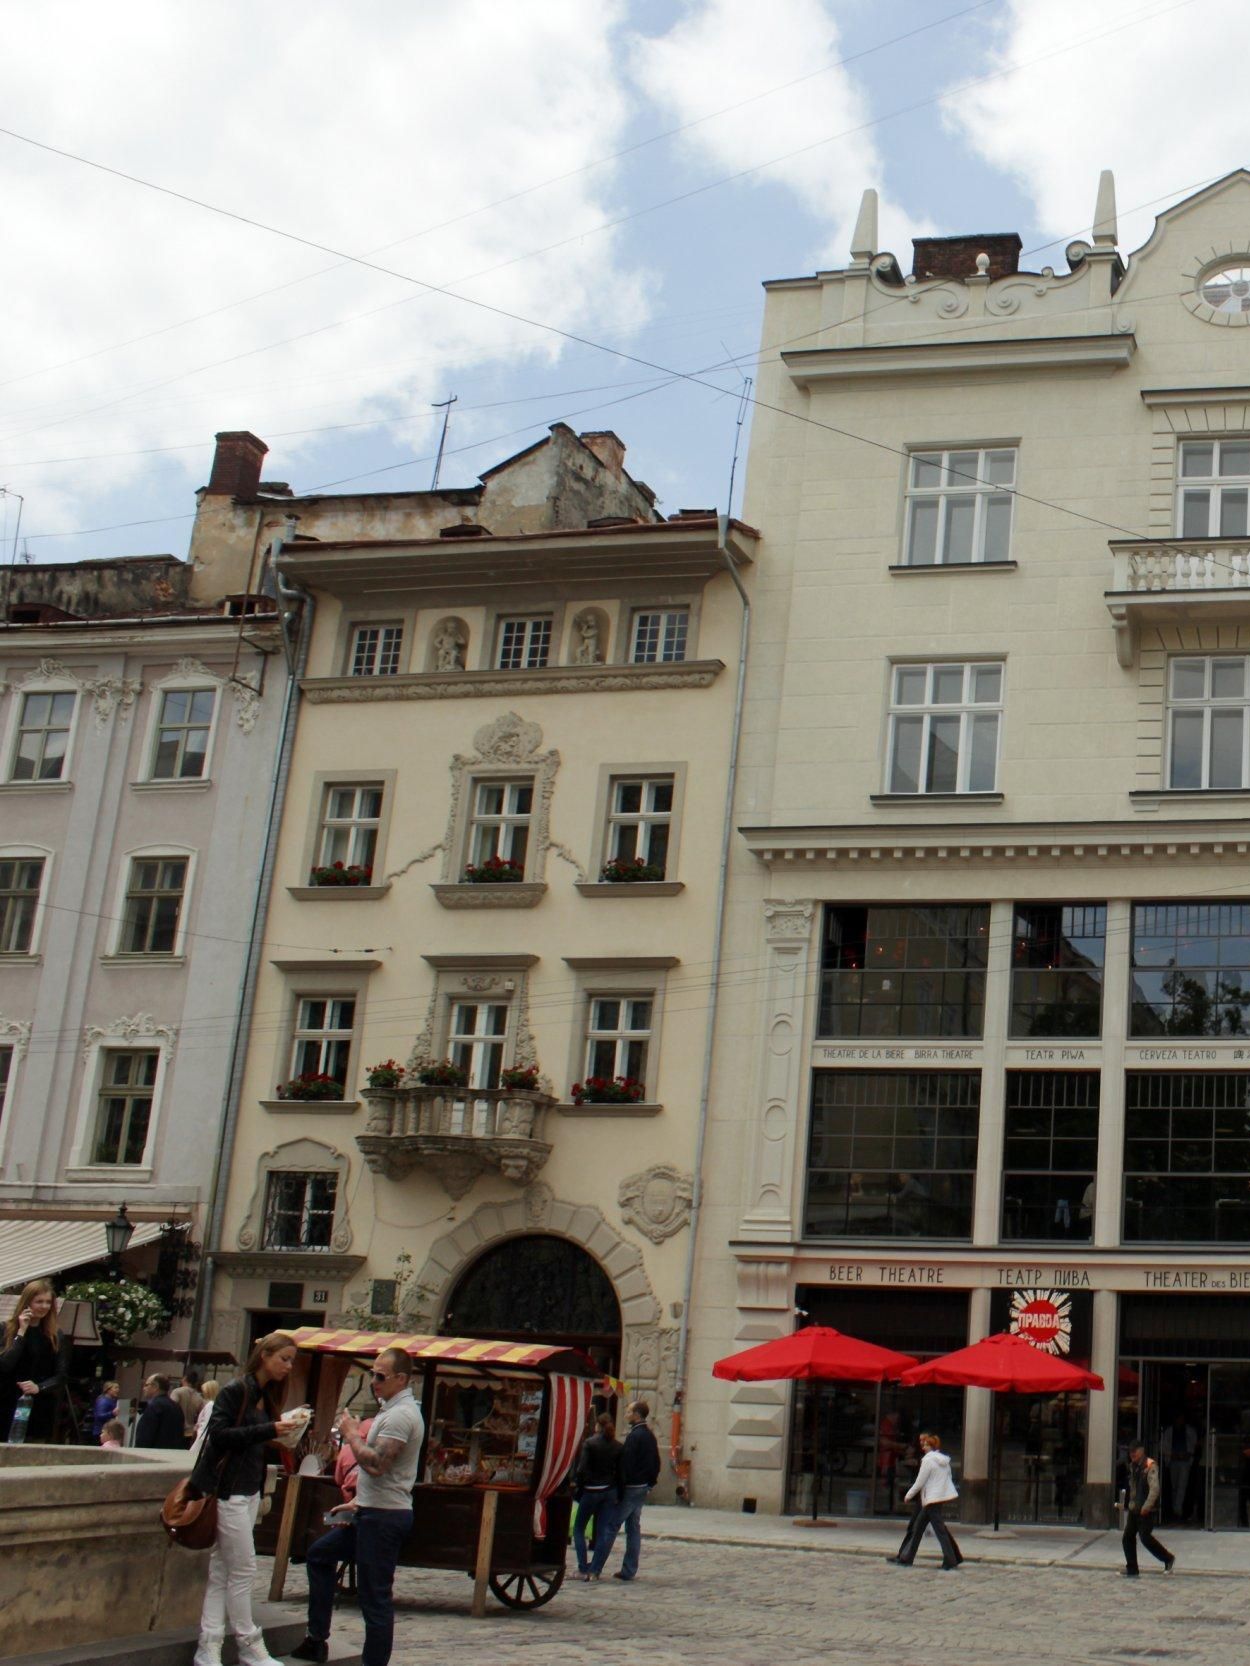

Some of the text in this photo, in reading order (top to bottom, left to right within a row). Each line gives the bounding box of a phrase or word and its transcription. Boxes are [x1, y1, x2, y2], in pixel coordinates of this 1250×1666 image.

[858, 1049, 869, 1059] DE
[871, 1049, 882, 1059] LA
[914, 1049, 938, 1059] BIRRA
[1025, 1049, 1085, 1060] TEATR PIWA
[1139, 1049, 1217, 1060] CERVEZA TEATRO
[829, 1265, 944, 1283] BEER THEATRE
[997, 1268, 1090, 1286] ТЕАТР ПИВА
[1144, 1271, 1208, 1288] THEATER
[1018, 1313, 1060, 1328] ПРАВДА
